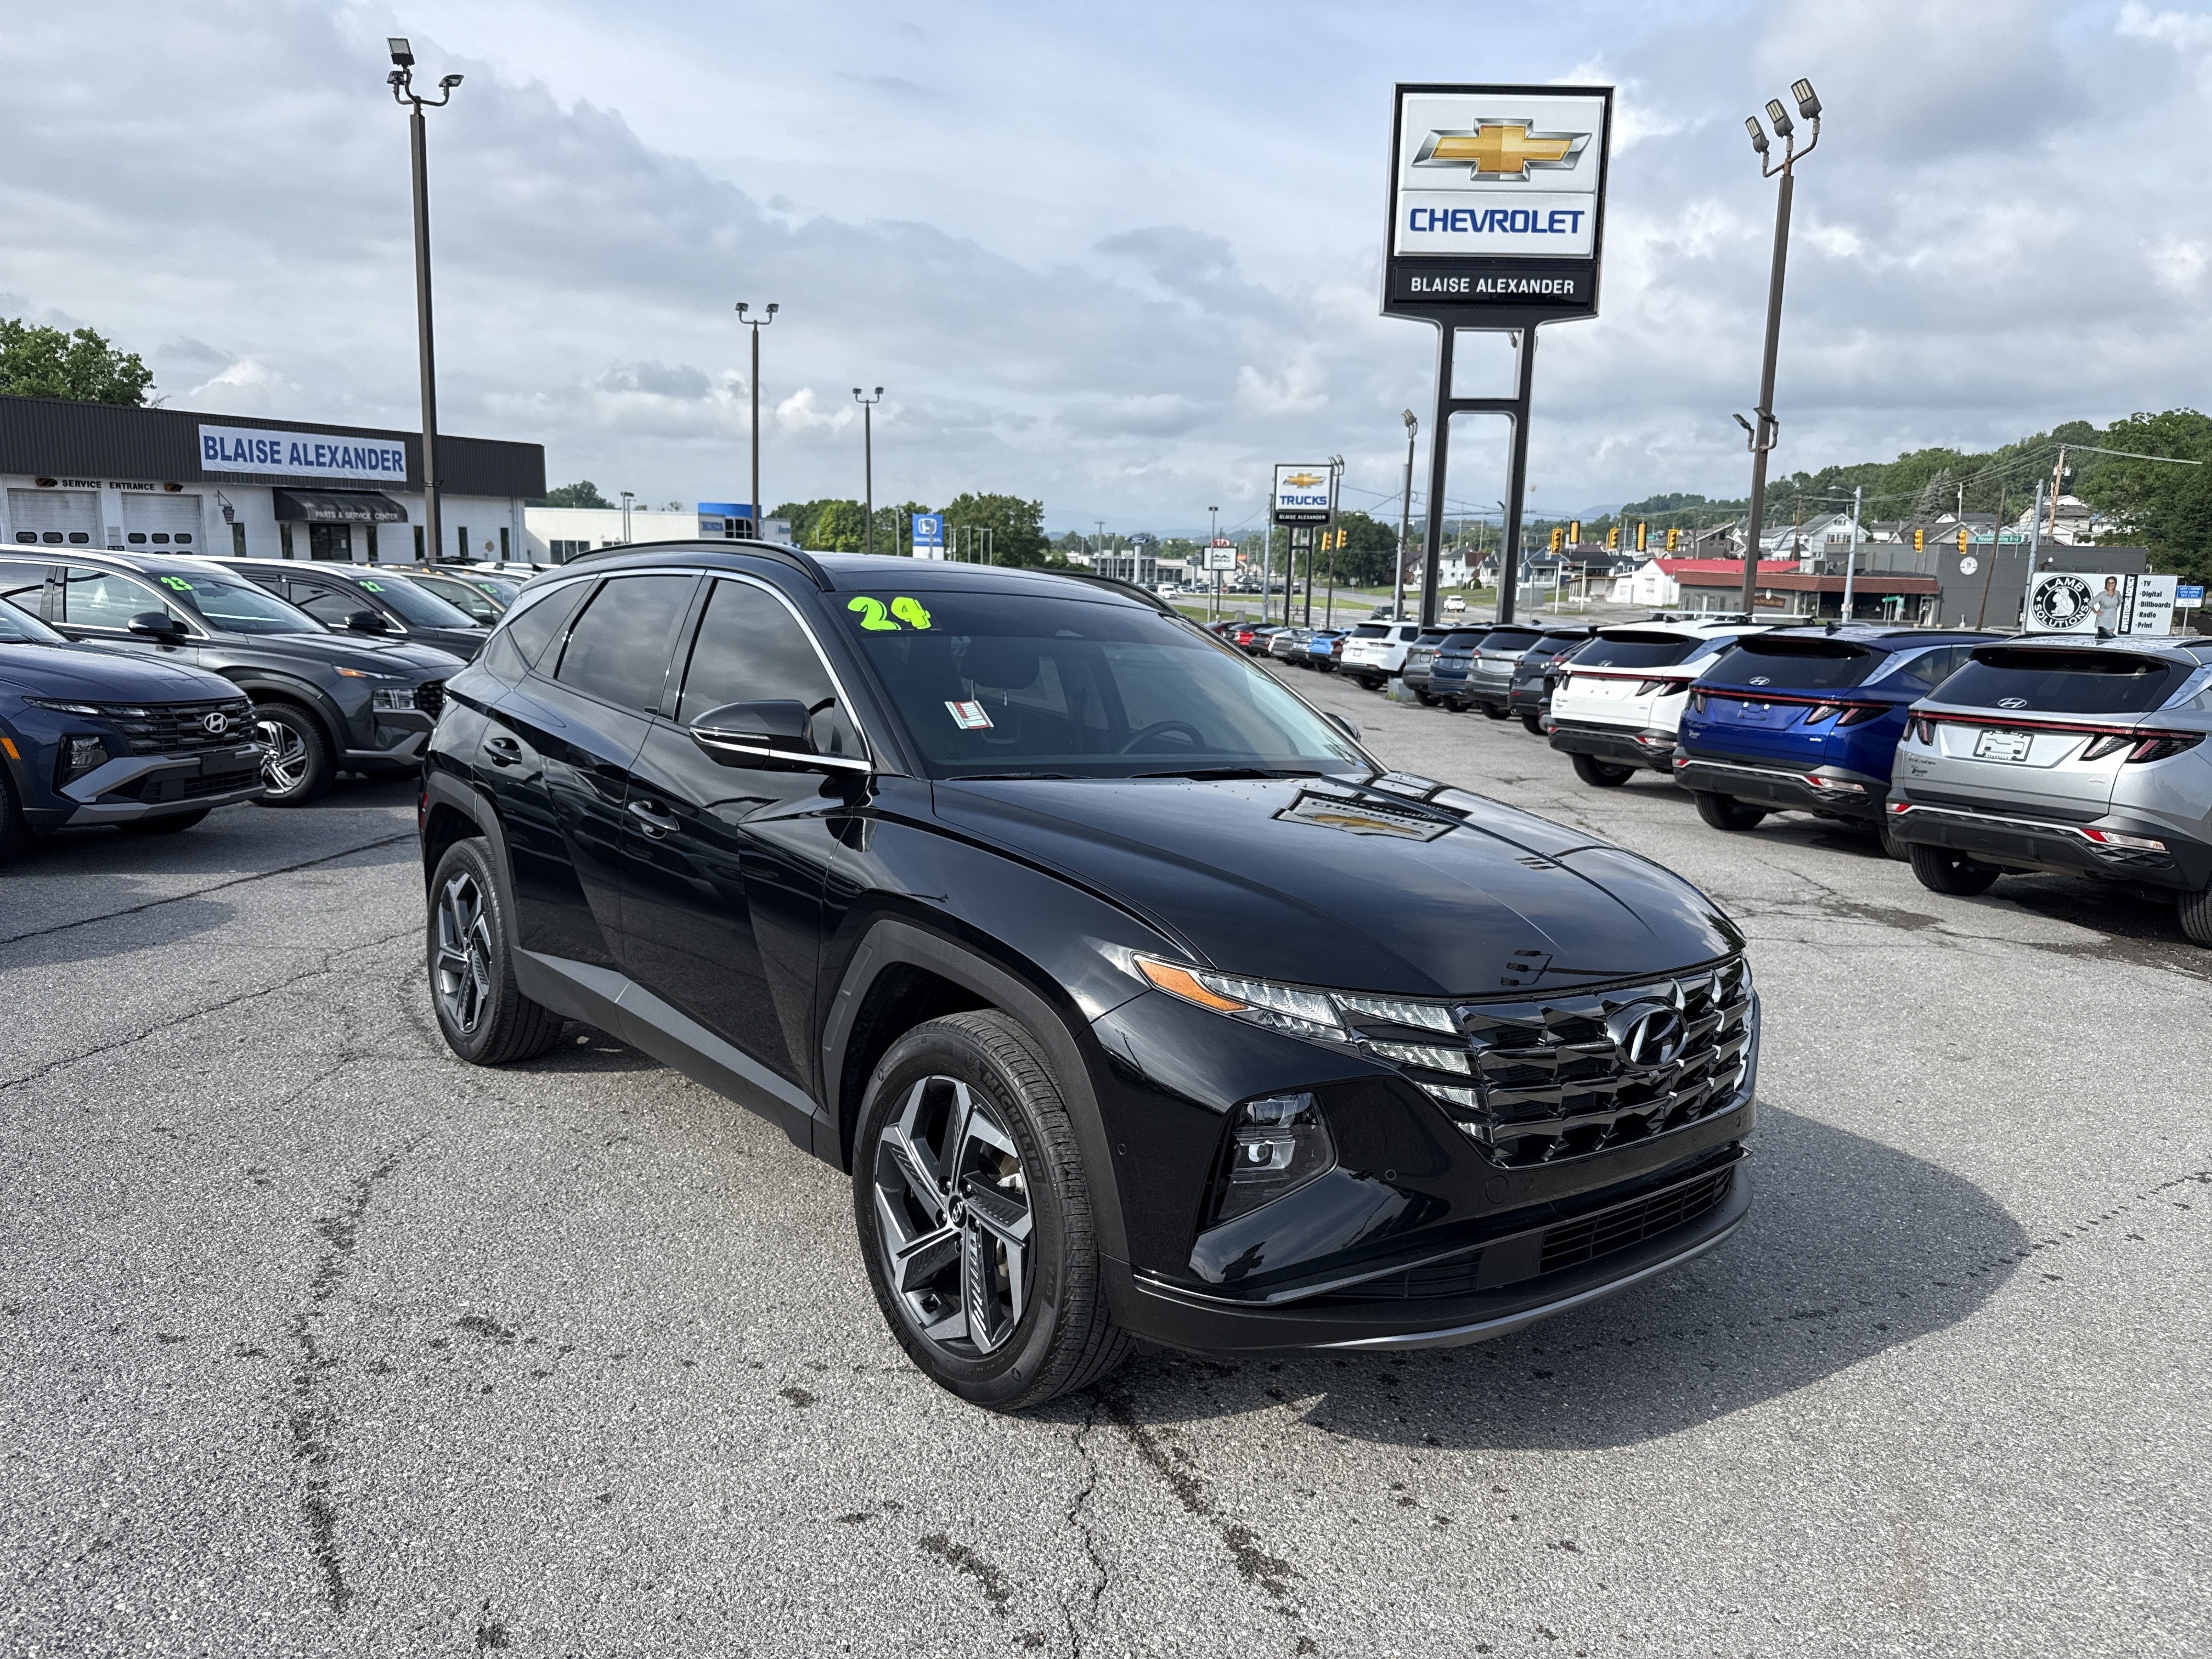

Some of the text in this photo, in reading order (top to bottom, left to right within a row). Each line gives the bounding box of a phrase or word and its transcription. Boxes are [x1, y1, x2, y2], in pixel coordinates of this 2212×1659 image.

[1409, 208, 1584, 233] CHEVROLET
[1410, 277, 1574, 294] BLAISE ALEXANDER
[204, 436, 404, 472] BLAISE ALEXANDER
[62, 479, 155, 490] SERVICE ENTRANCE
[1280, 496, 1327, 505] TRUCKS
[345, 511, 371, 520] SERVICE
[161, 577, 194, 591] 23
[2044, 577, 2085, 592] LAMB
[848, 596, 931, 631] 24
[2034, 603, 2089, 628] SOLUTIONS
[2120, 575, 2135, 632] ADVERTISING AGENCY
[983, 1071, 1042, 1177] MICHELIN
[1042, 1199, 1055, 1276] PRIMACY
